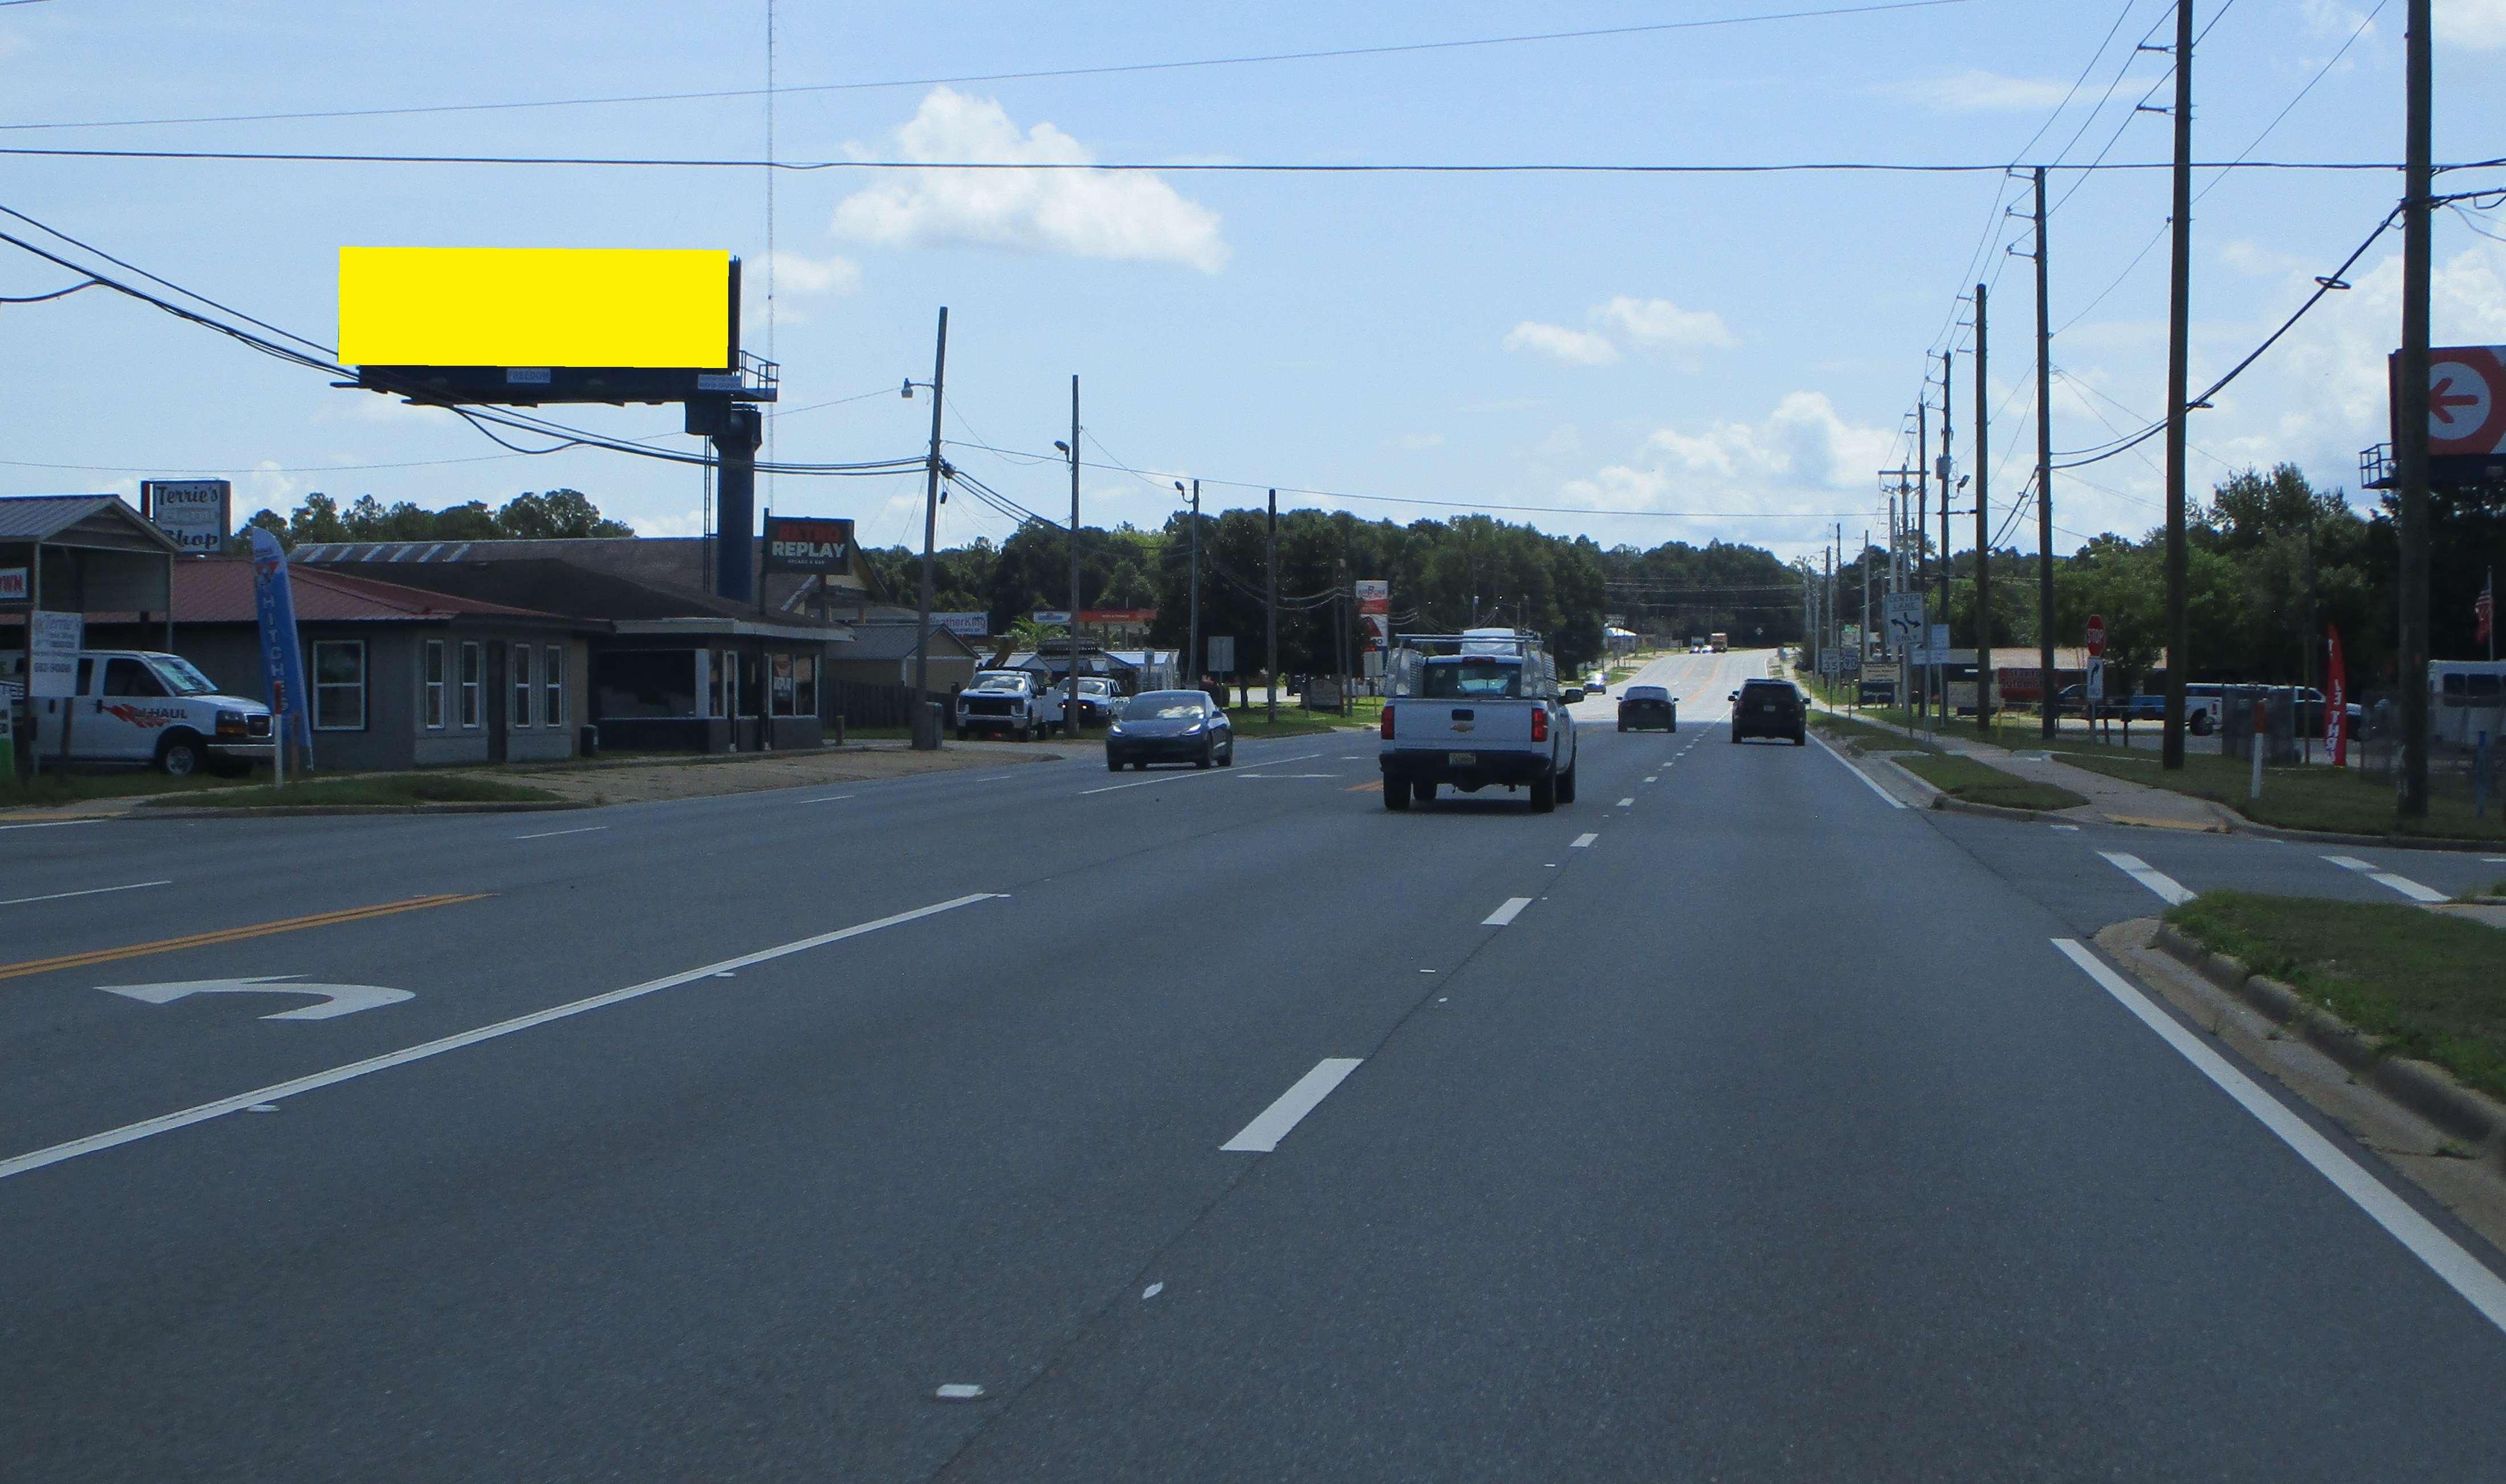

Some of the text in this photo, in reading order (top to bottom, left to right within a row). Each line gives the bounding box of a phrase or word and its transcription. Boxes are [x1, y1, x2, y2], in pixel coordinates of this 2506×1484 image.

[156, 486, 219, 505] Terrie's
[779, 525, 840, 541] RETRO
[772, 541, 846, 558] REPLAY
[2087, 628, 2104, 643] STOP
[1824, 661, 1838, 670] 35
[1844, 659, 1857, 667] 90
[2001, 678, 2042, 688] Automot
